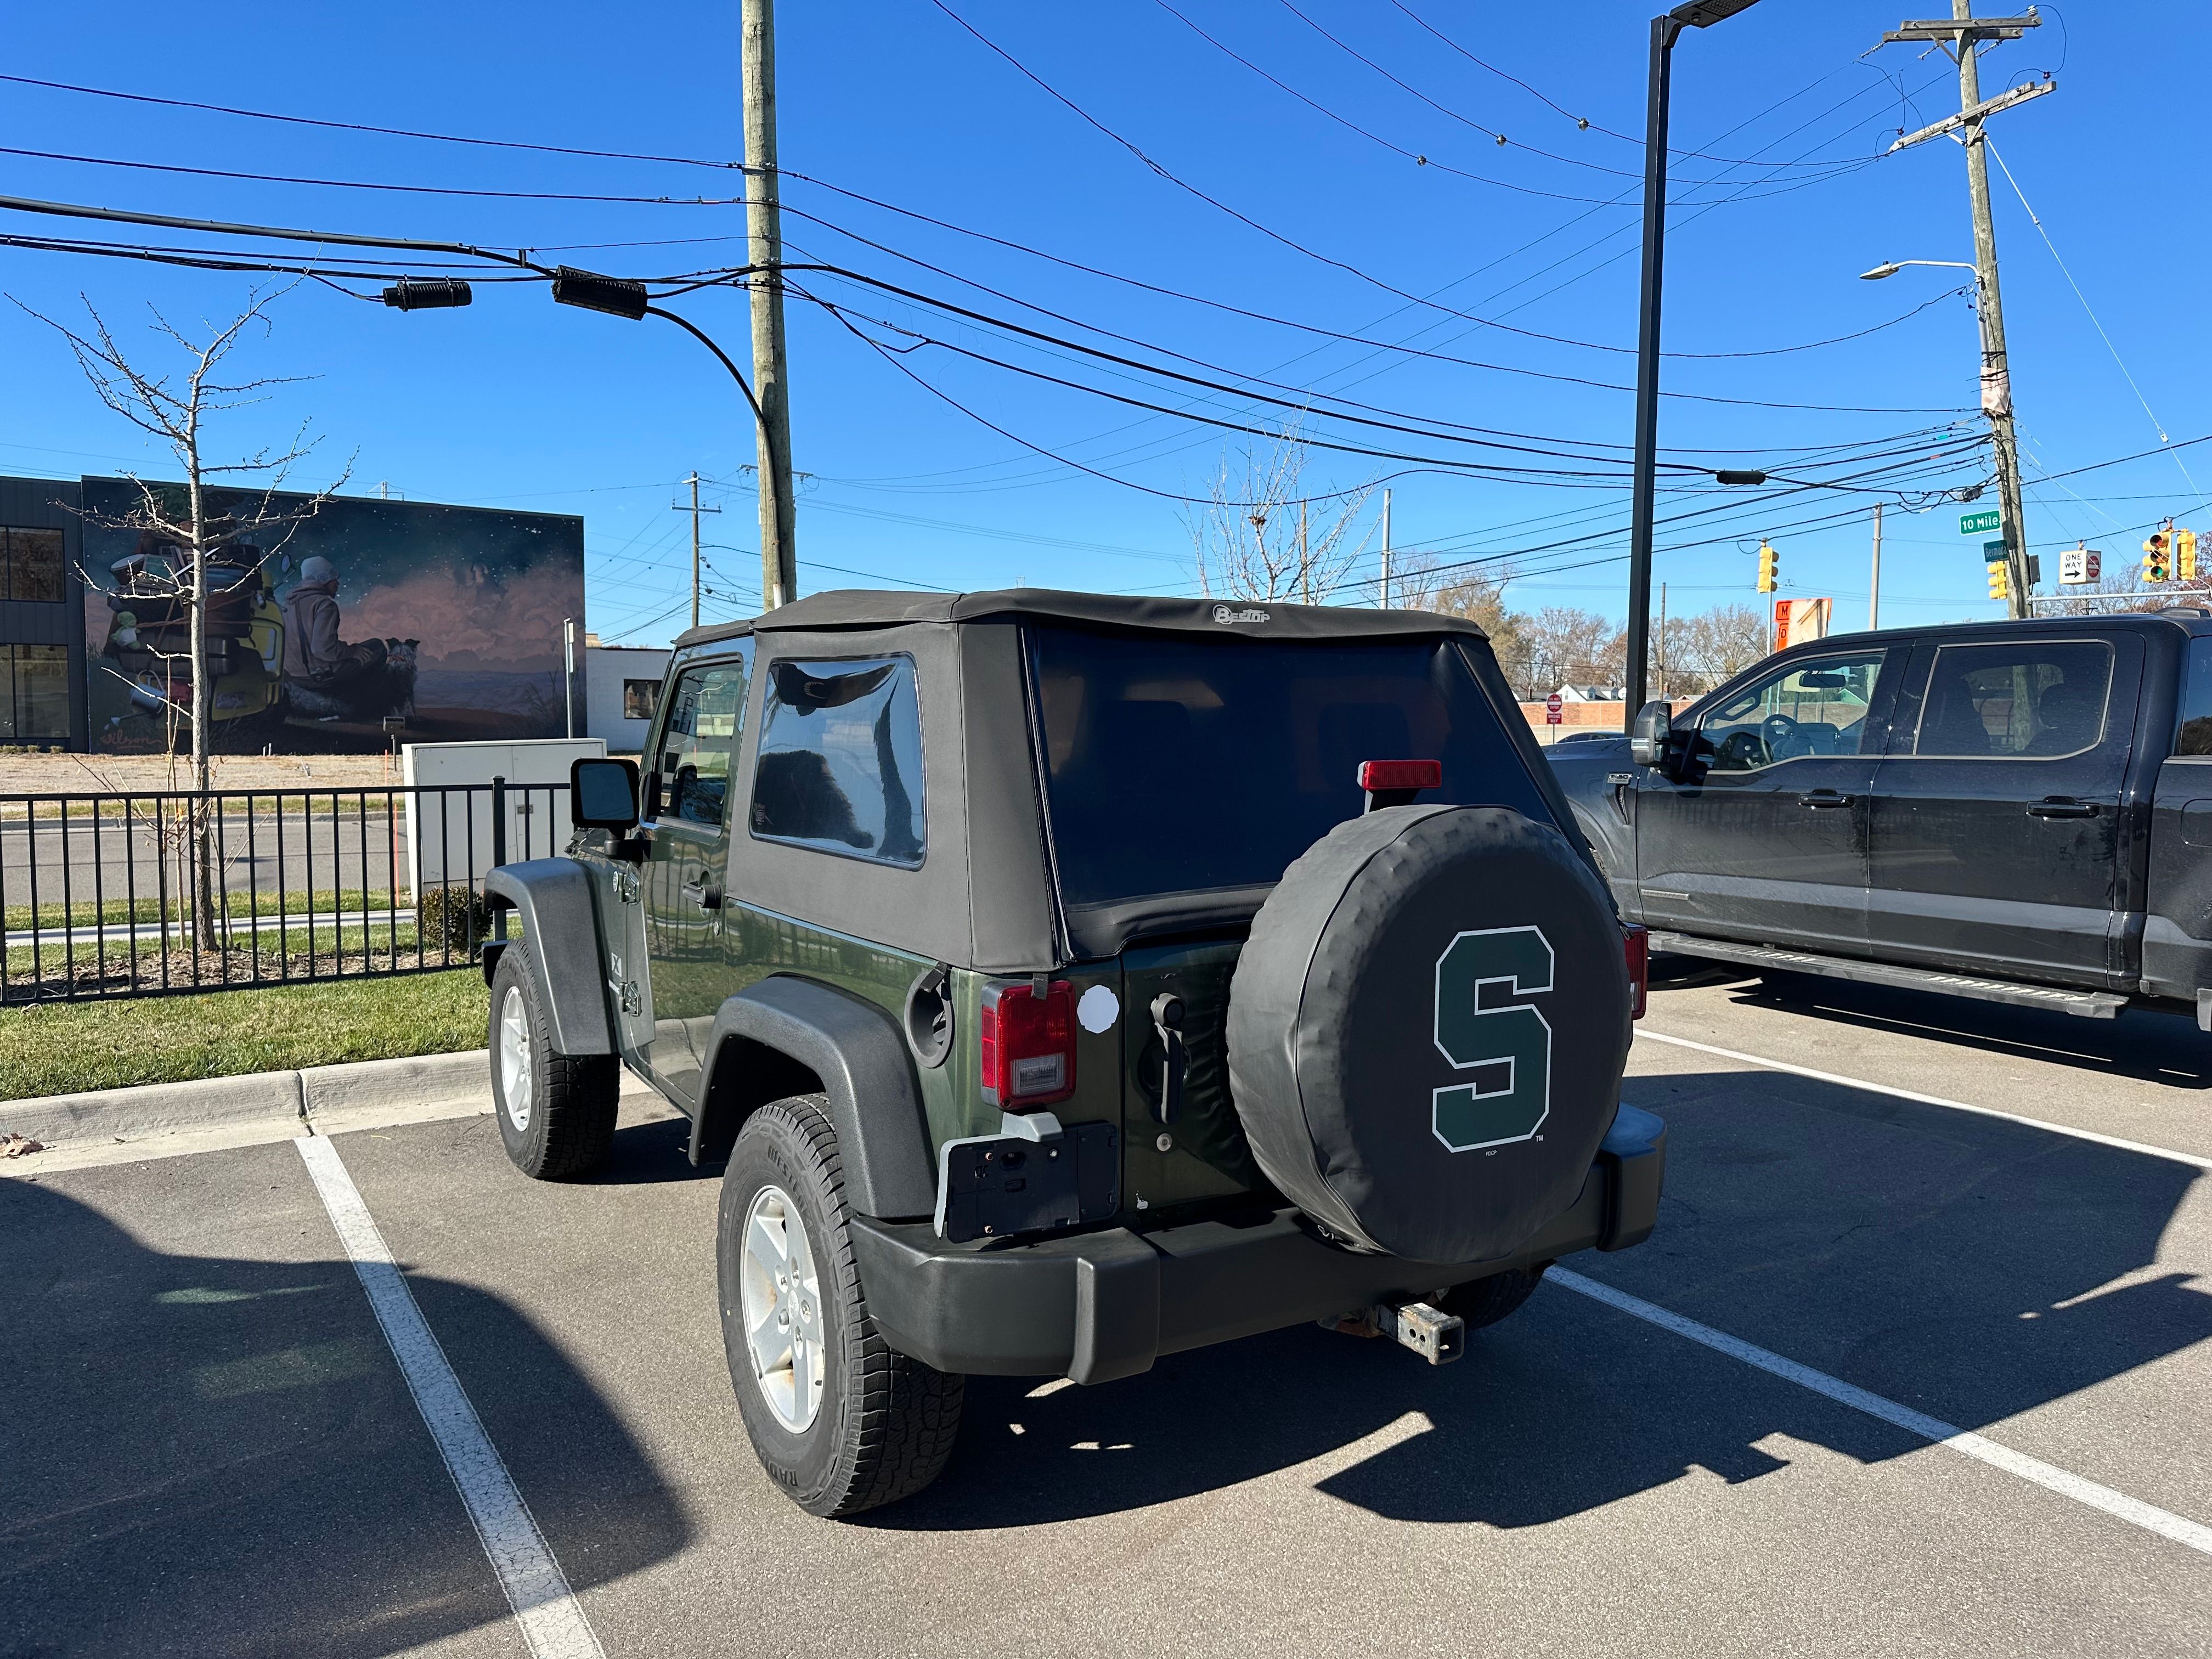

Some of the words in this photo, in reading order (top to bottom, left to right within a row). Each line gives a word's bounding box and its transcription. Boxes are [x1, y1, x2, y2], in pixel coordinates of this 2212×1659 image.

[1962, 519, 1974, 531] 10
[1977, 516, 1999, 528] Mile
[1985, 544, 2007, 557] Bermuda
[1432, 926, 1554, 1153] S
